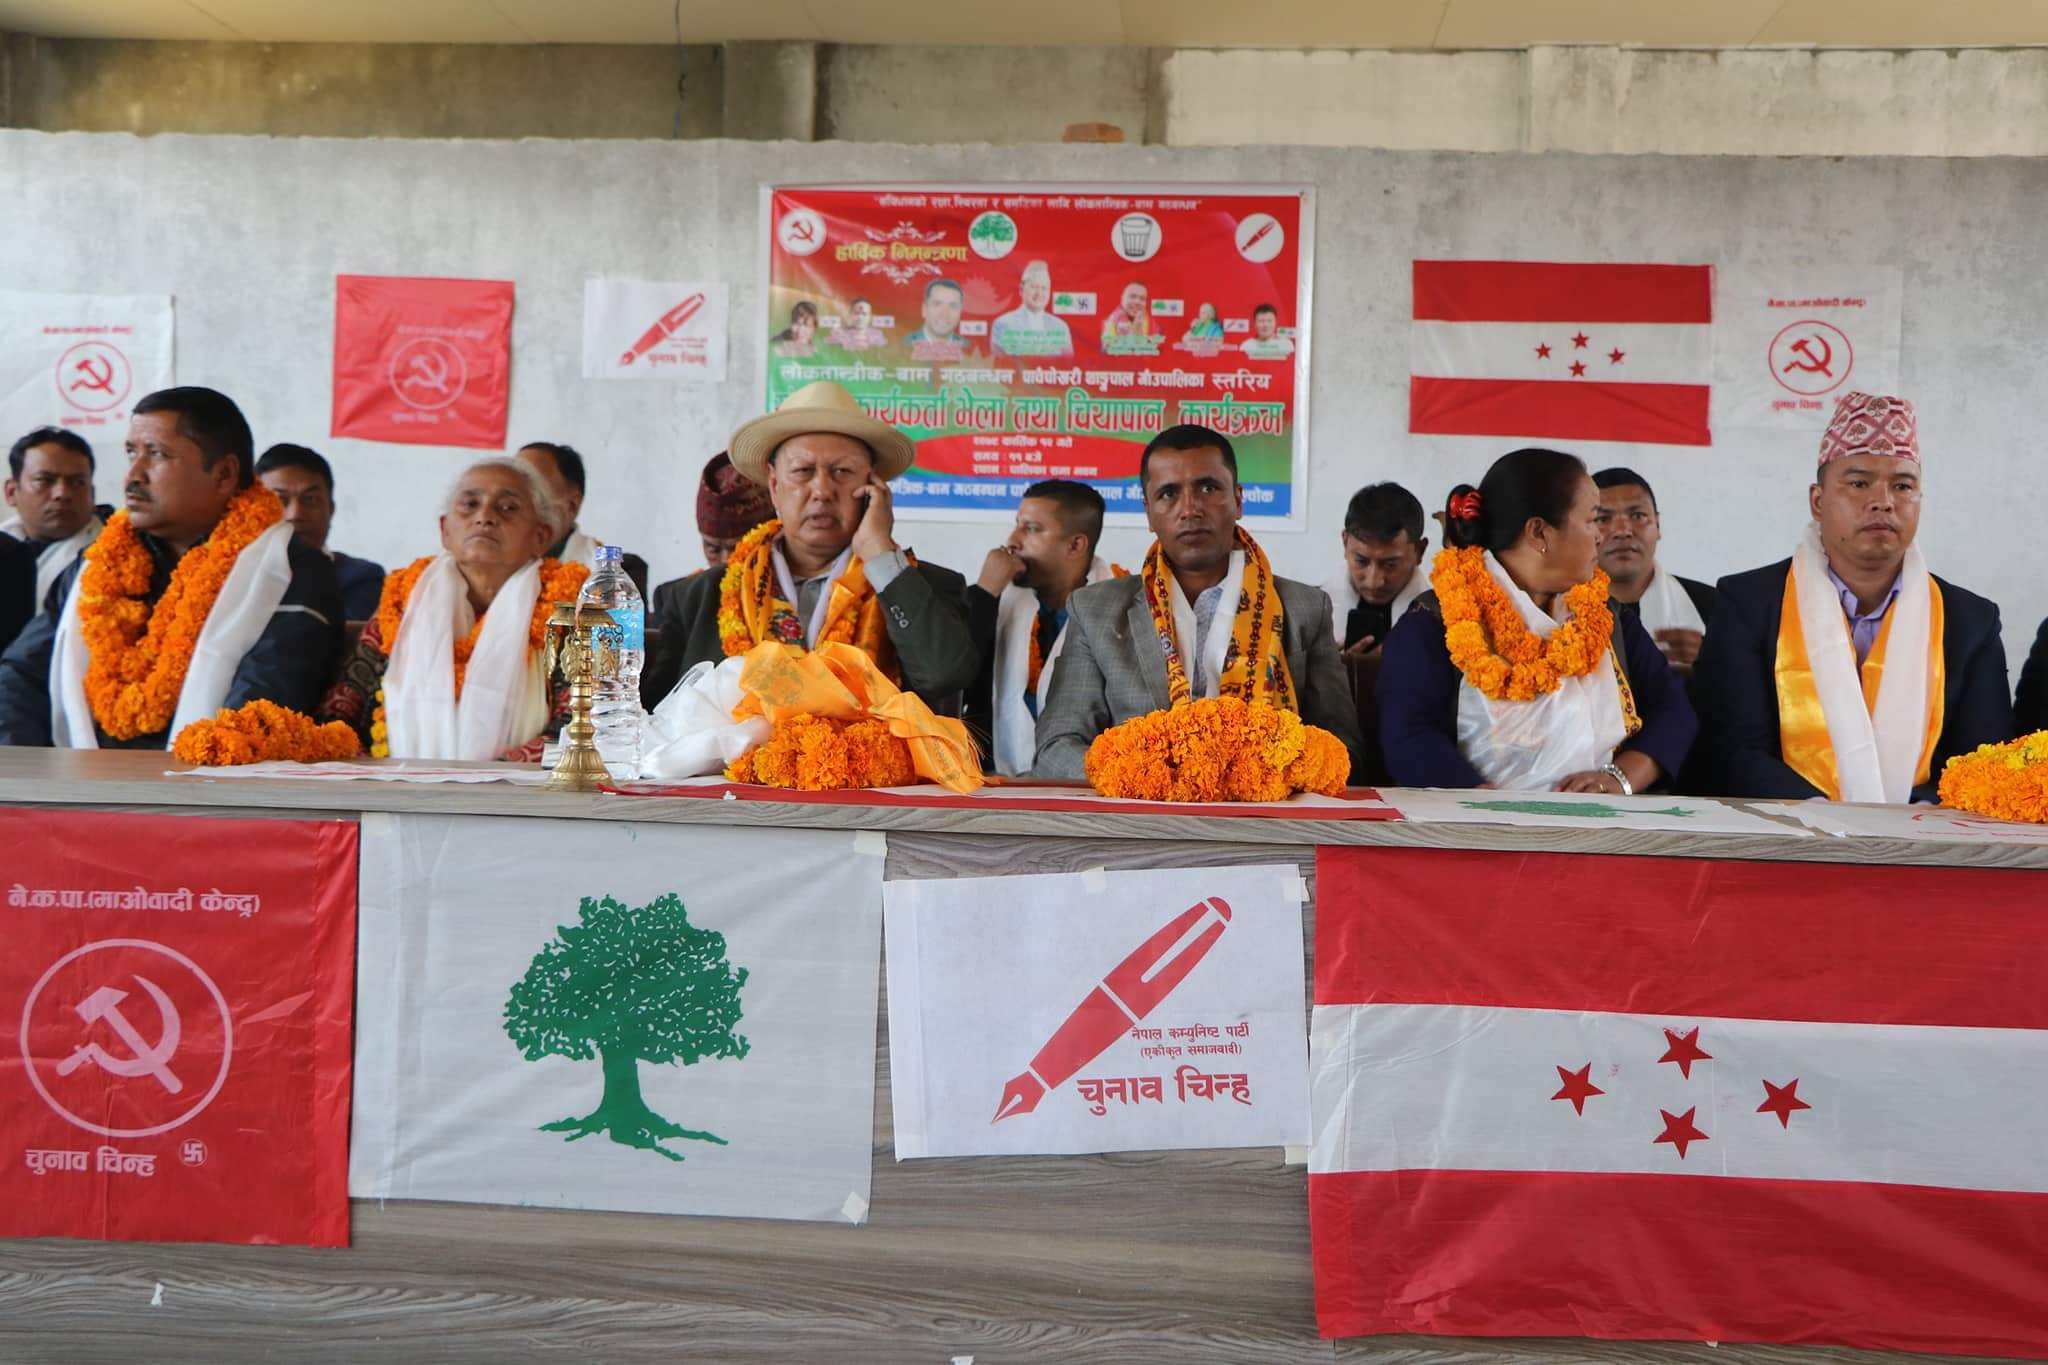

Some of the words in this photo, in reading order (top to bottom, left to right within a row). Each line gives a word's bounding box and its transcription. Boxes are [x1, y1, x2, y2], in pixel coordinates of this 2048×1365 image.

[1211, 367, 1273, 392] स्तरिय
[1012, 396, 1060, 432] तथा
[1065, 386, 1166, 433] चियापान
[1131, 1026, 1162, 1041] नेपाल
[1225, 1022, 1250, 1038] पार्टी
[1187, 1042, 1242, 1057] समाजवादी)
[1077, 1074, 1164, 1116] चुनाव
[1174, 1064, 1253, 1106] चिन्ह
[25, 1148, 89, 1176] चुनाव
[97, 1145, 157, 1177] चिन्ह
